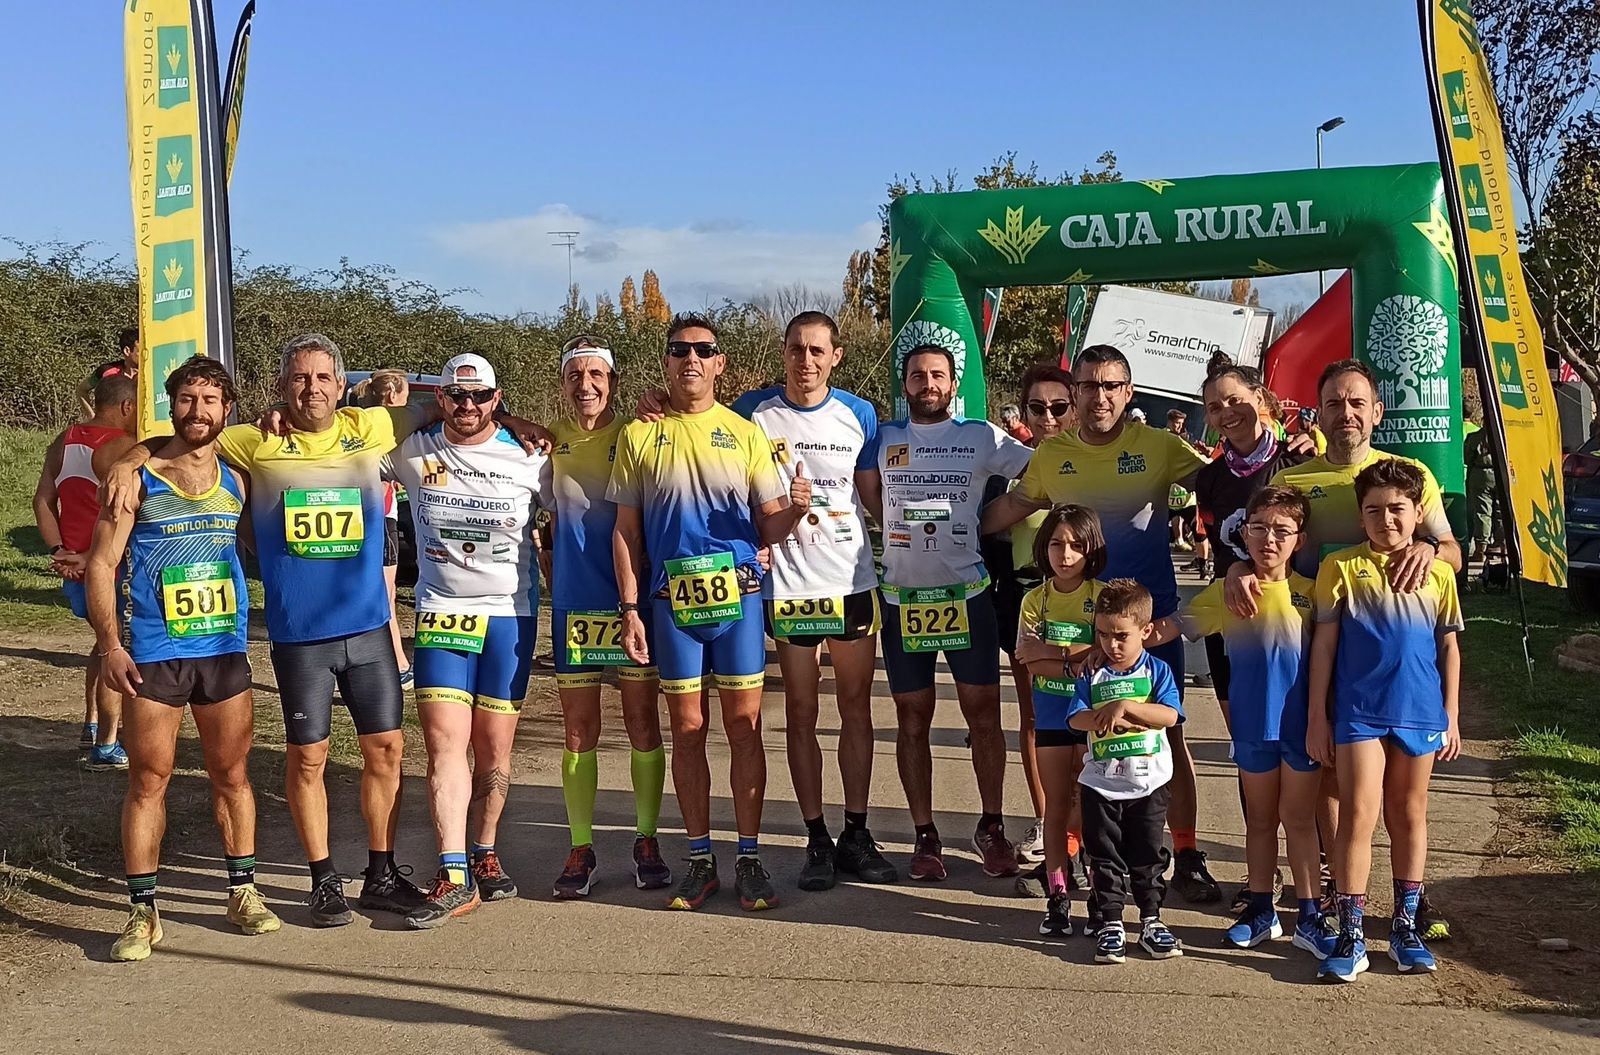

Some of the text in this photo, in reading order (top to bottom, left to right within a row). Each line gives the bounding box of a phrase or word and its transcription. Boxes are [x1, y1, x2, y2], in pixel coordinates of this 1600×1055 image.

[1479, 148, 1509, 257] Valladolid
[1060, 200, 1327, 249] CAJA RURAL
[1506, 271, 1529, 355] Ourense
[1526, 368, 1544, 417] León
[1378, 416, 1451, 431] UNDACION
[1405, 429, 1451, 443] RURAL
[711, 441, 737, 450] DUERO
[1118, 465, 1147, 474] DUERO
[888, 474, 968, 485] TRIATLON DUERO
[422, 492, 464, 507] TRIATLON
[473, 499, 511, 511] DUERO
[927, 491, 957, 501] VALDÉS
[161, 519, 207, 535] TRIATLON
[294, 512, 353, 540] 507
[465, 516, 502, 527] VALDÉS
[310, 544, 361, 554] CAJA RURAL
[676, 575, 729, 605] 458
[176, 585, 227, 616] 501
[693, 609, 739, 620] CAJA RURAL
[907, 607, 961, 635] 522
[572, 619, 625, 645] 372
[796, 622, 841, 630] CAJA RURAL
[432, 635, 480, 647] CAJA RURAL
[941, 637, 968, 646] RURAL
[1047, 681, 1064, 690] CAJA
[1108, 744, 1130, 752] CAJA
